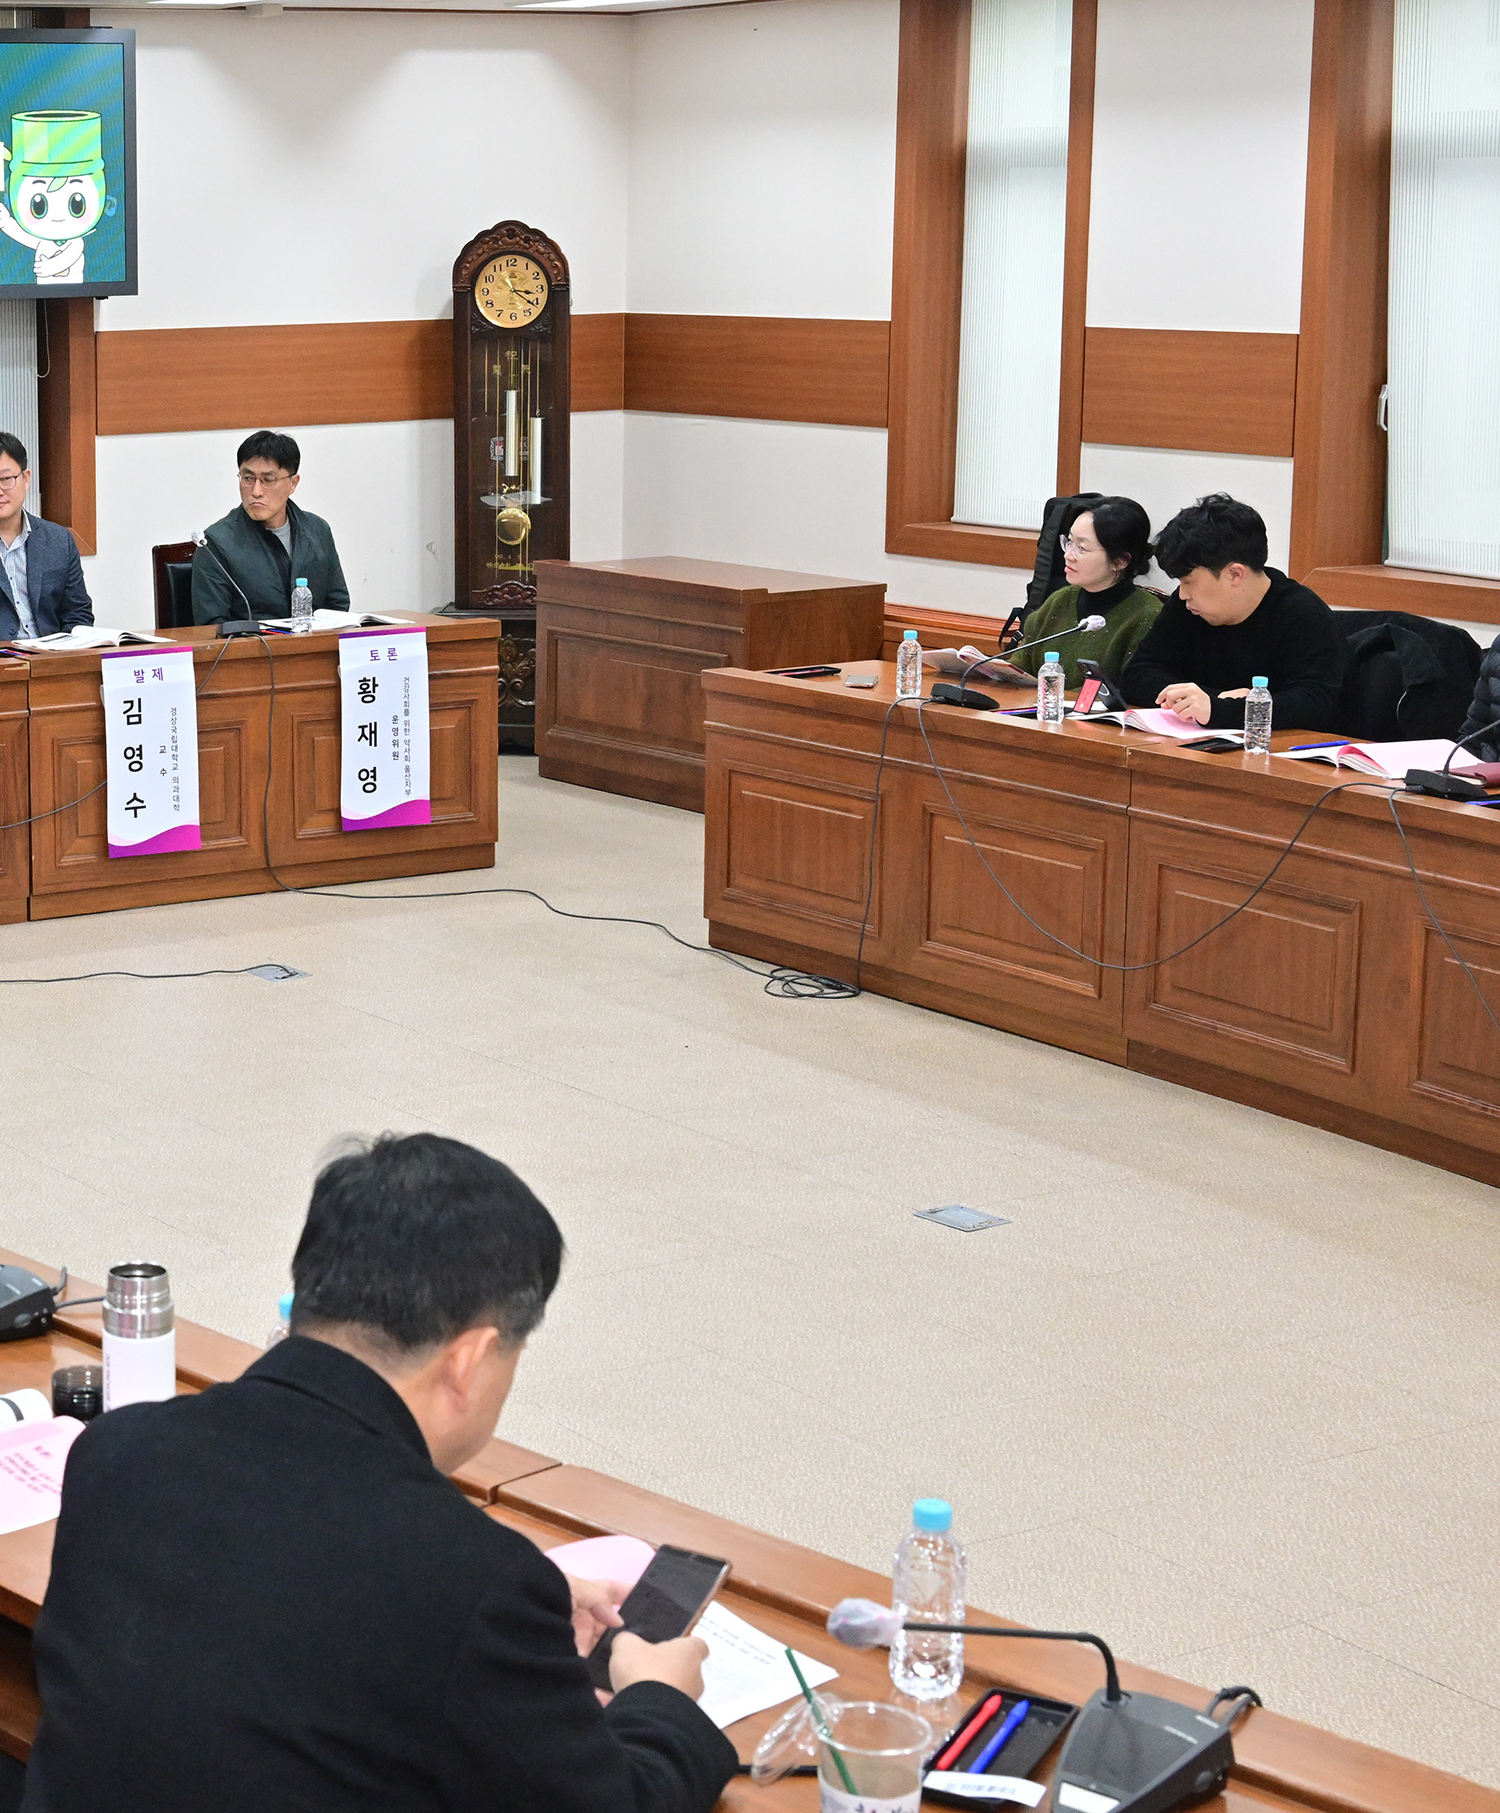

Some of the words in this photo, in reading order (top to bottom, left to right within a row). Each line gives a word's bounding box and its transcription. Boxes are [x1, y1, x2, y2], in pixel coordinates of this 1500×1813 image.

[506, 258, 518, 267] 12
[493, 264, 503, 272] 11
[484, 274, 495, 284] 10
[532, 271, 540, 280] 2
[482, 287, 490, 296] 9
[536, 284, 544, 293] 3
[485, 300, 494, 309] 8
[496, 309, 504, 318] 7
[509, 312, 518, 321] 6
[523, 308, 532, 317] 5
[369, 647, 399, 663] 토론
[133, 667, 165, 684] 발제
[357, 676, 379, 794] 황재영
[391, 714, 400, 761] 운영위원
[122, 697, 147, 819] 김영수
[158, 745, 168, 777] 교수
